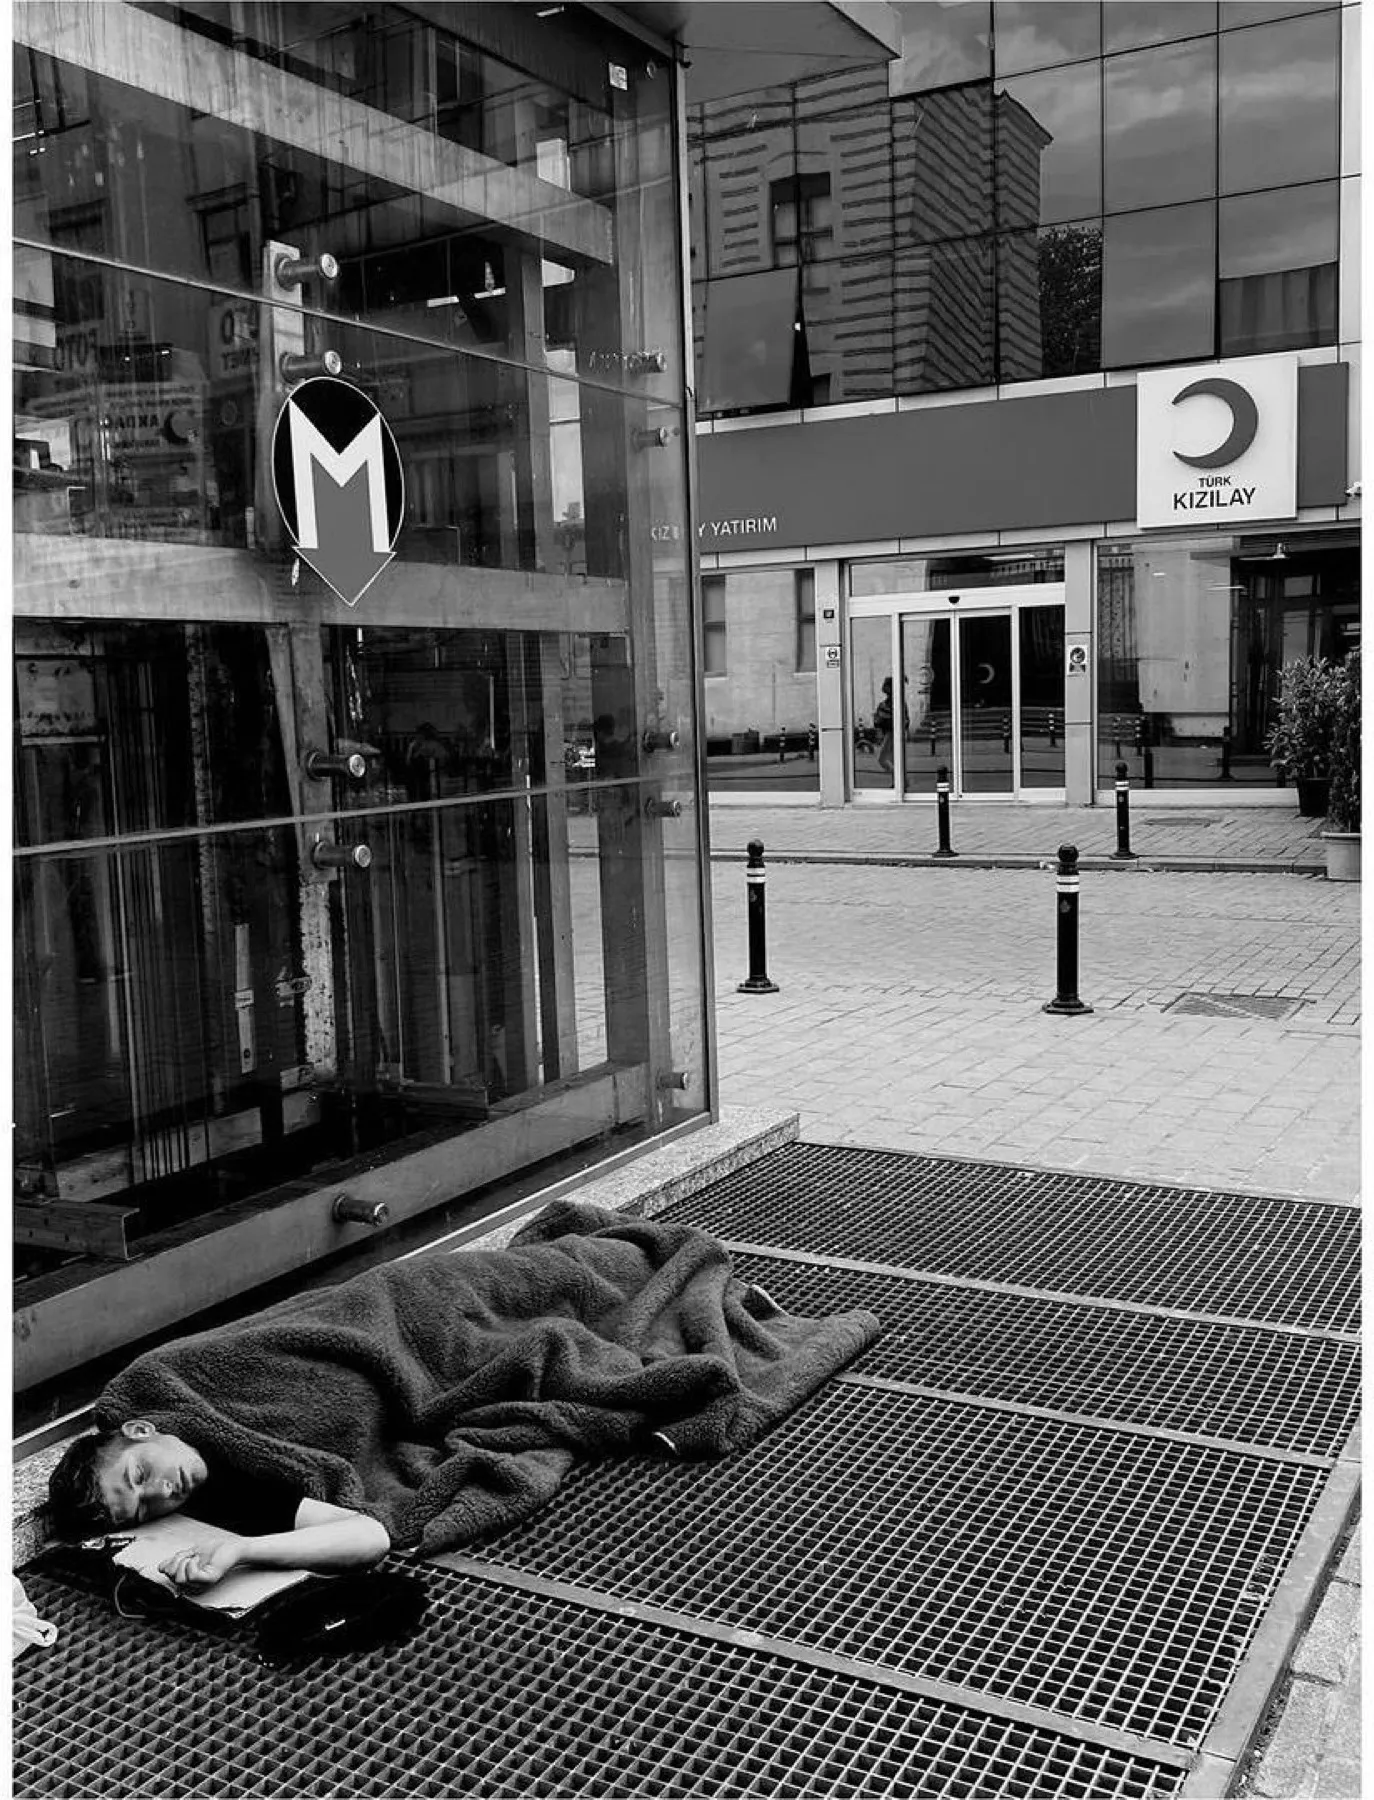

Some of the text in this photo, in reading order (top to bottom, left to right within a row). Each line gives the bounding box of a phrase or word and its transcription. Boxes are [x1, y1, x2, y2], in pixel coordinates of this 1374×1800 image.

[288, 397, 390, 553] M
[1198, 475, 1231, 488] TÜRK
[1173, 487, 1256, 511] KIZILAY
[710, 516, 777, 536] YATIRIM
